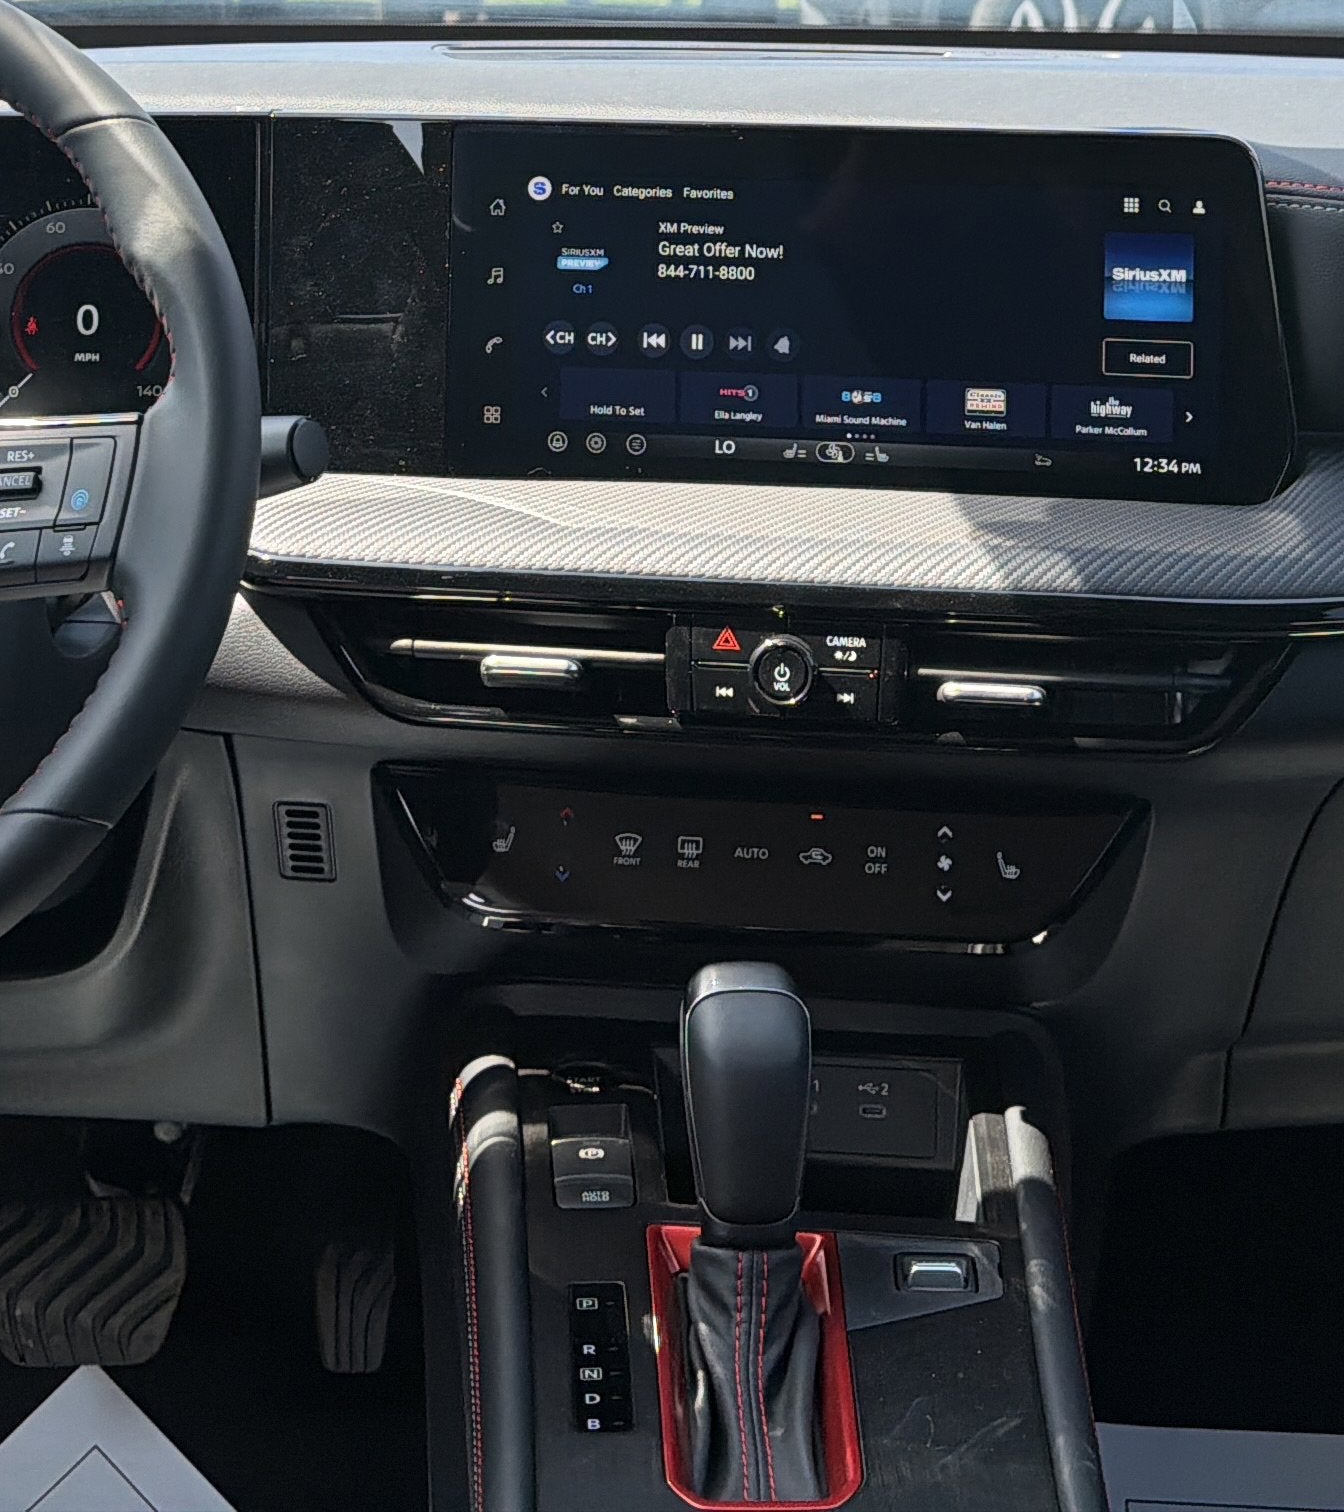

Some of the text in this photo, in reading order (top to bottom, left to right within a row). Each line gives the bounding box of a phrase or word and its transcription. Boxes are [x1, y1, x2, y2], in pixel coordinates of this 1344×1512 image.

[561, 184, 603, 196] For You
[613, 185, 672, 199] Categories
[683, 188, 734, 200] Favorites
[46, 221, 65, 235] 60
[658, 222, 724, 235] XM Preview
[658, 241, 784, 259] Great Offer Now!
[657, 264, 755, 280] 844-711-8800
[1112, 267, 1186, 282] SiriusXM
[573, 284, 593, 294] Ch 1
[76, 304, 99, 336] 0
[74, 352, 100, 363] MPH
[1129, 353, 1166, 365] Related
[137, 384, 162, 397] 140
[590, 405, 645, 416] Hold To Set
[1091, 401, 1132, 418] highway
[731, 411, 762, 422] Langley
[816, 415, 907, 426] Miami Sound Machine
[965, 421, 1006, 430] Van Halen
[1075, 425, 1147, 436] Parker McCollum
[714, 440, 736, 454] LO
[7, 451, 35, 462] RES+
[1134, 457, 1202, 474] 12:34 PM
[826, 635, 867, 648] CAMERA
[773, 682, 791, 692] VOL
[734, 847, 769, 859] AUTO
[867, 846, 886, 858] ON
[613, 856, 641, 866] FRONT
[677, 860, 700, 868] REAR
[865, 863, 888, 874] OFF
[881, 1083, 888, 1095] 2
[583, 1299, 592, 1308] P
[583, 1345, 596, 1355] R
[585, 1369, 598, 1379] N
[585, 1393, 600, 1404] D
[587, 1419, 600, 1429] B
